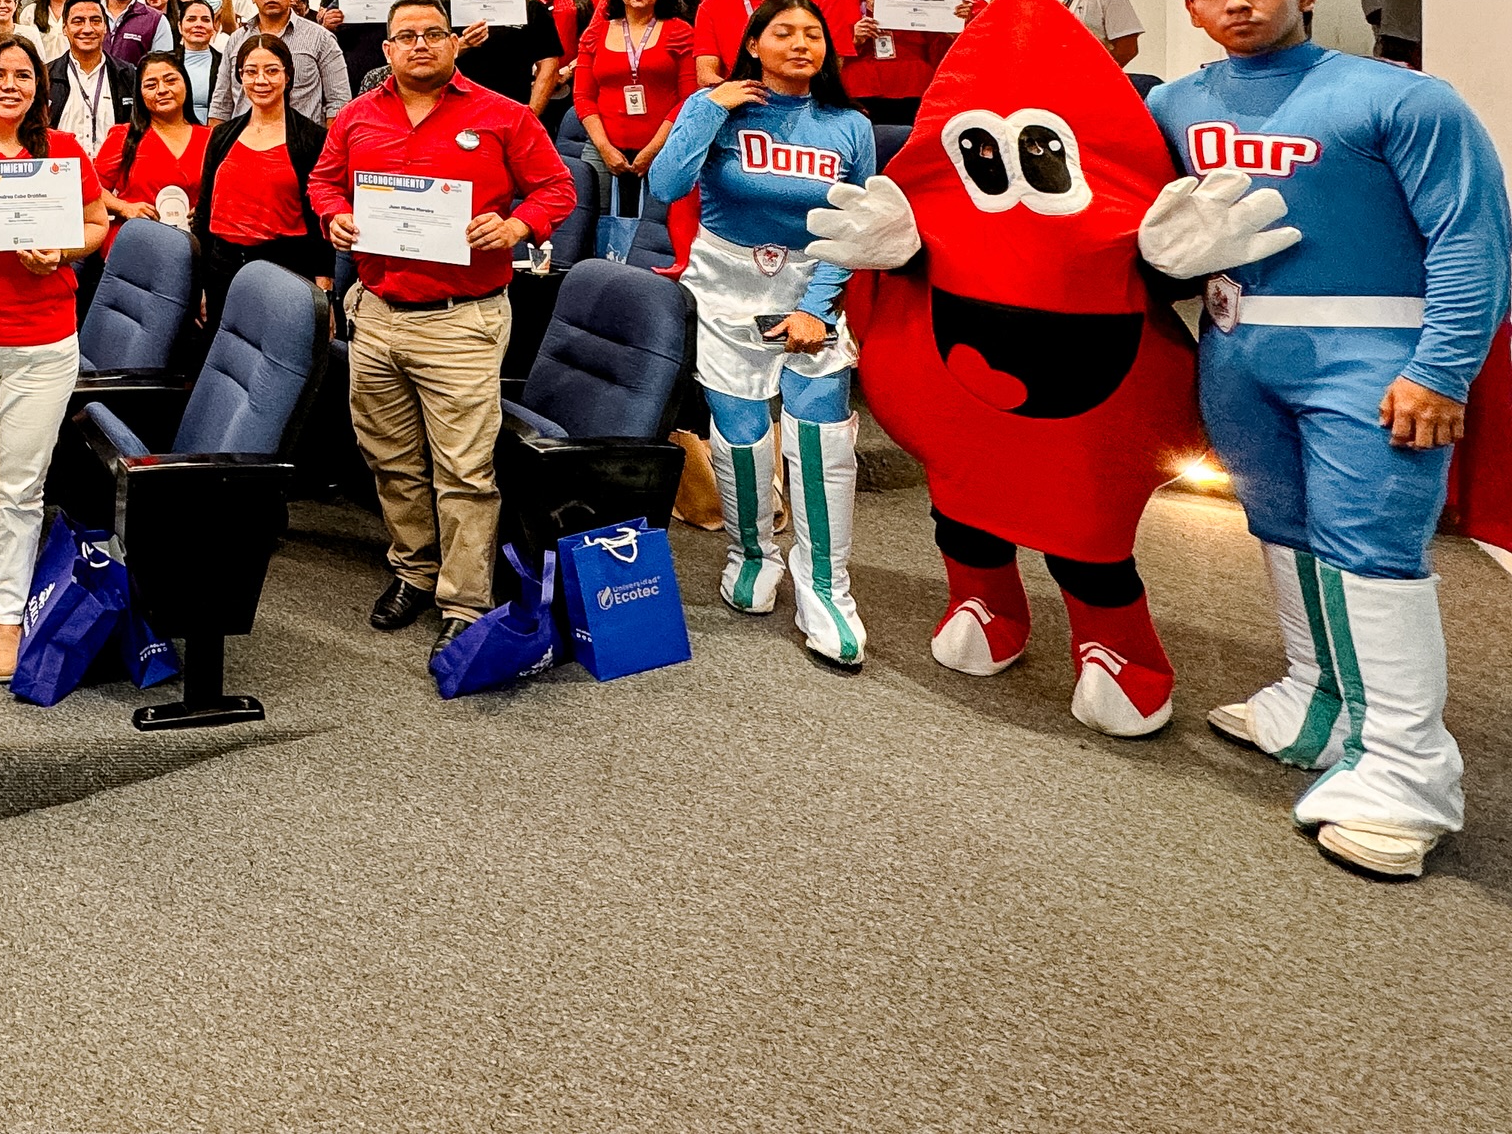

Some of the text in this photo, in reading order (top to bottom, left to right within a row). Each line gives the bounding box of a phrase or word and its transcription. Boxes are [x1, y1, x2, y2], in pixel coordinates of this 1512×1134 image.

[742, 133, 839, 180] Dona
[1193, 126, 1308, 172] Dor
[358, 173, 426, 189] RECONOCIMIENTO
[614, 585, 660, 605] Ecotec
